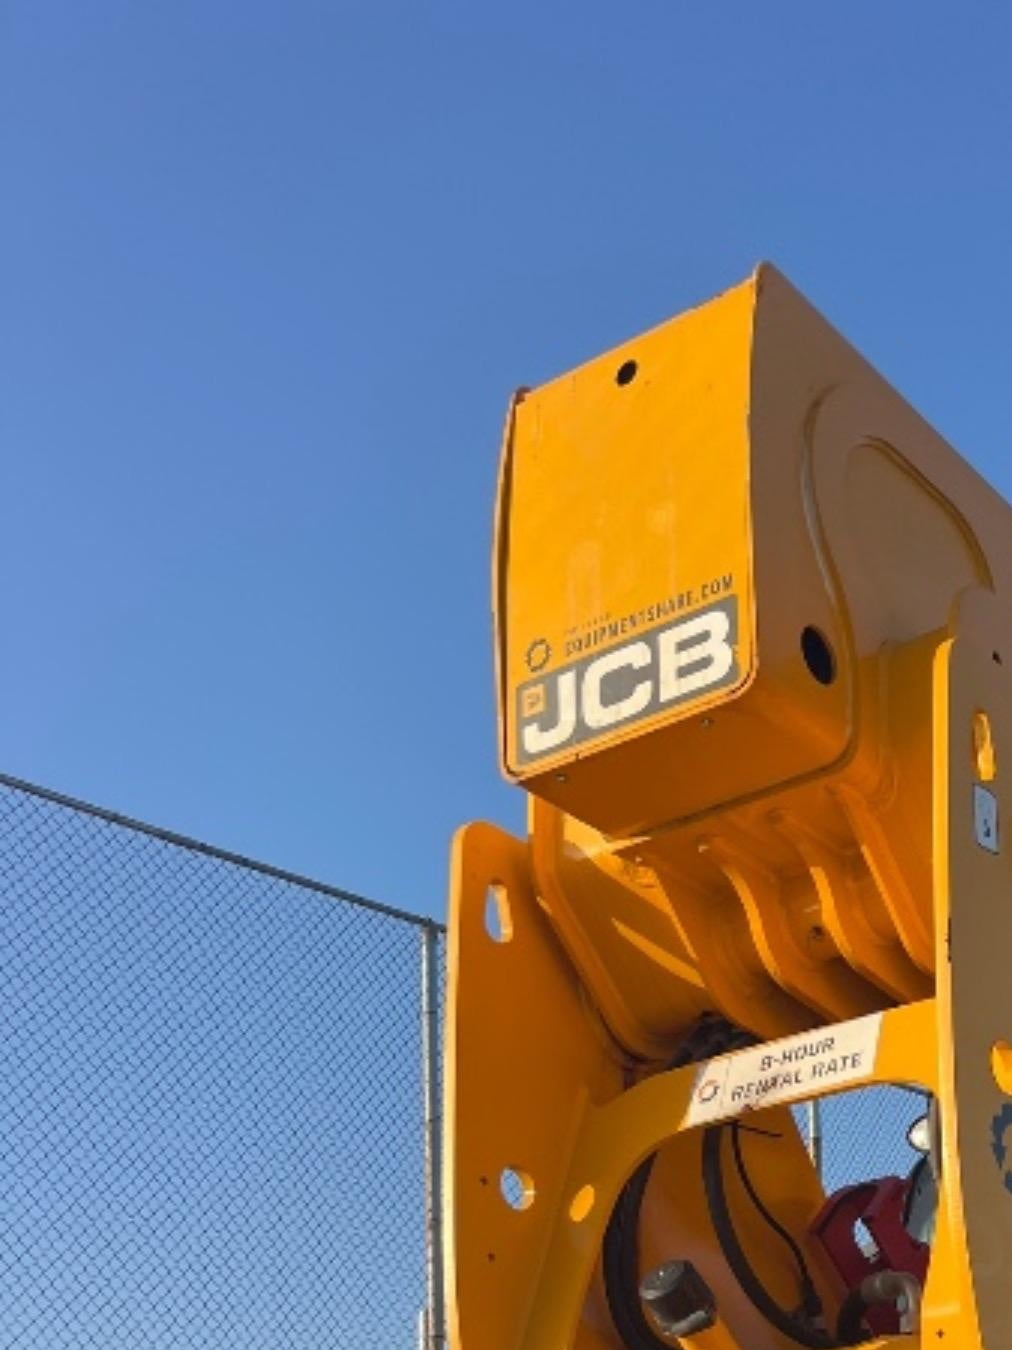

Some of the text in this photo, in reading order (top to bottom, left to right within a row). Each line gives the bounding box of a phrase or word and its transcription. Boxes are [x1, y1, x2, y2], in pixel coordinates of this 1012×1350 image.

[565, 573, 733, 656] EQUIPMENTSHARE.COM
[523, 611, 733, 753] JCB
[730, 1052, 863, 1102] RENTAL RATE
